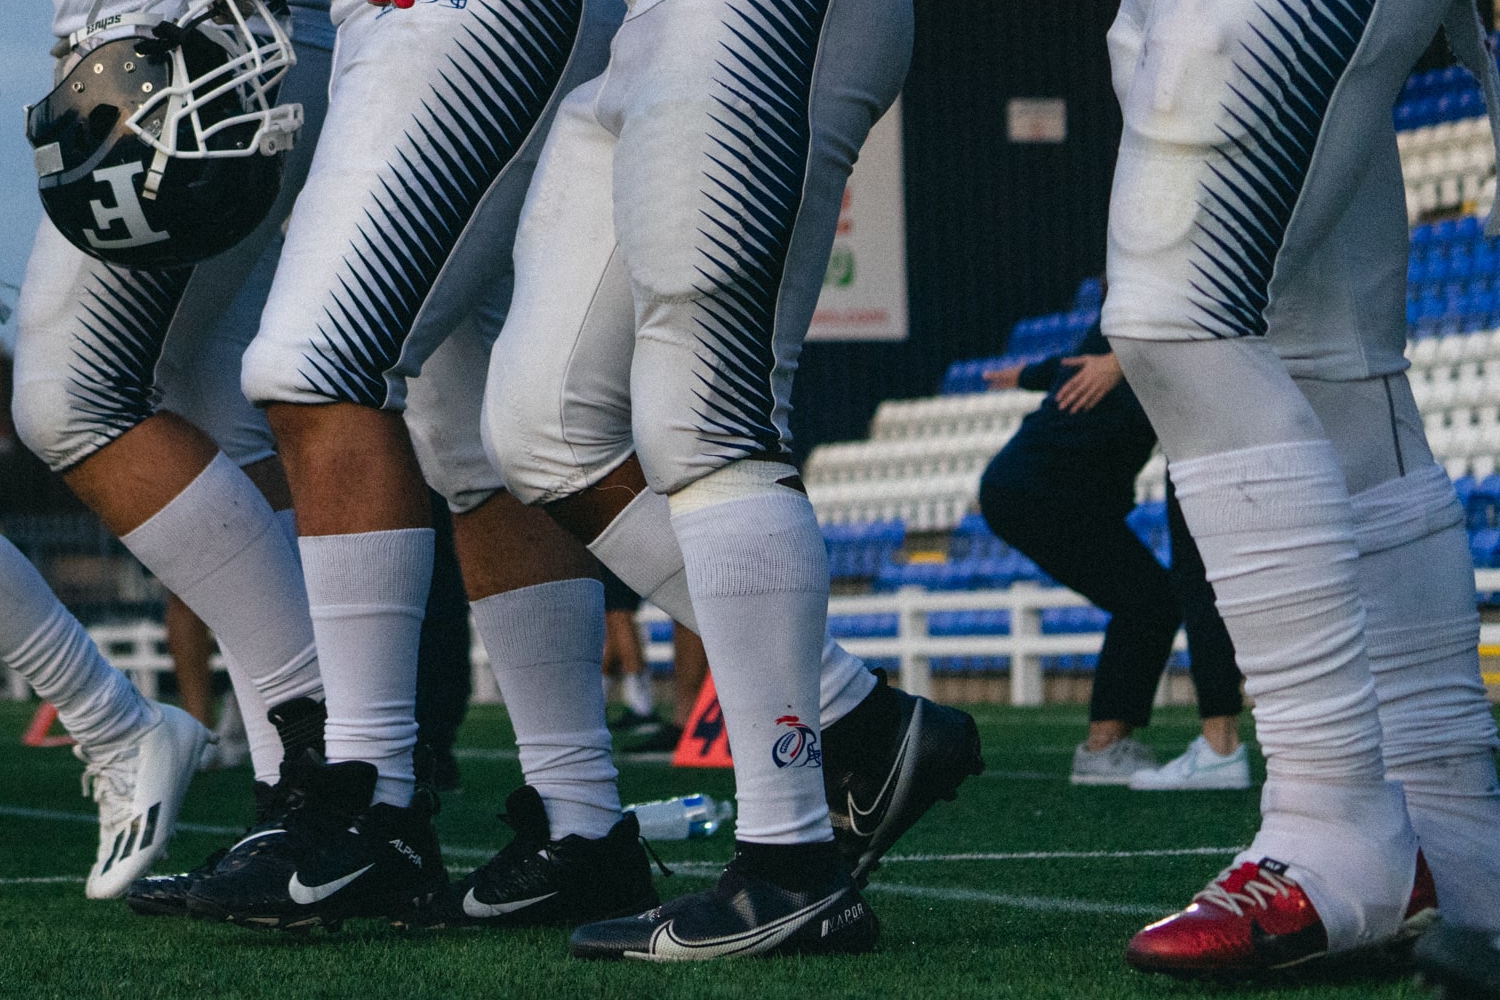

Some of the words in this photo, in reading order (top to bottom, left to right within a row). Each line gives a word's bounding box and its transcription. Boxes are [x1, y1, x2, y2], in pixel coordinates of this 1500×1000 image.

[82, 160, 171, 249] F
[692, 695, 732, 758] 4
[389, 839, 422, 868] ALPHA
[828, 903, 865, 931] VAPOR
